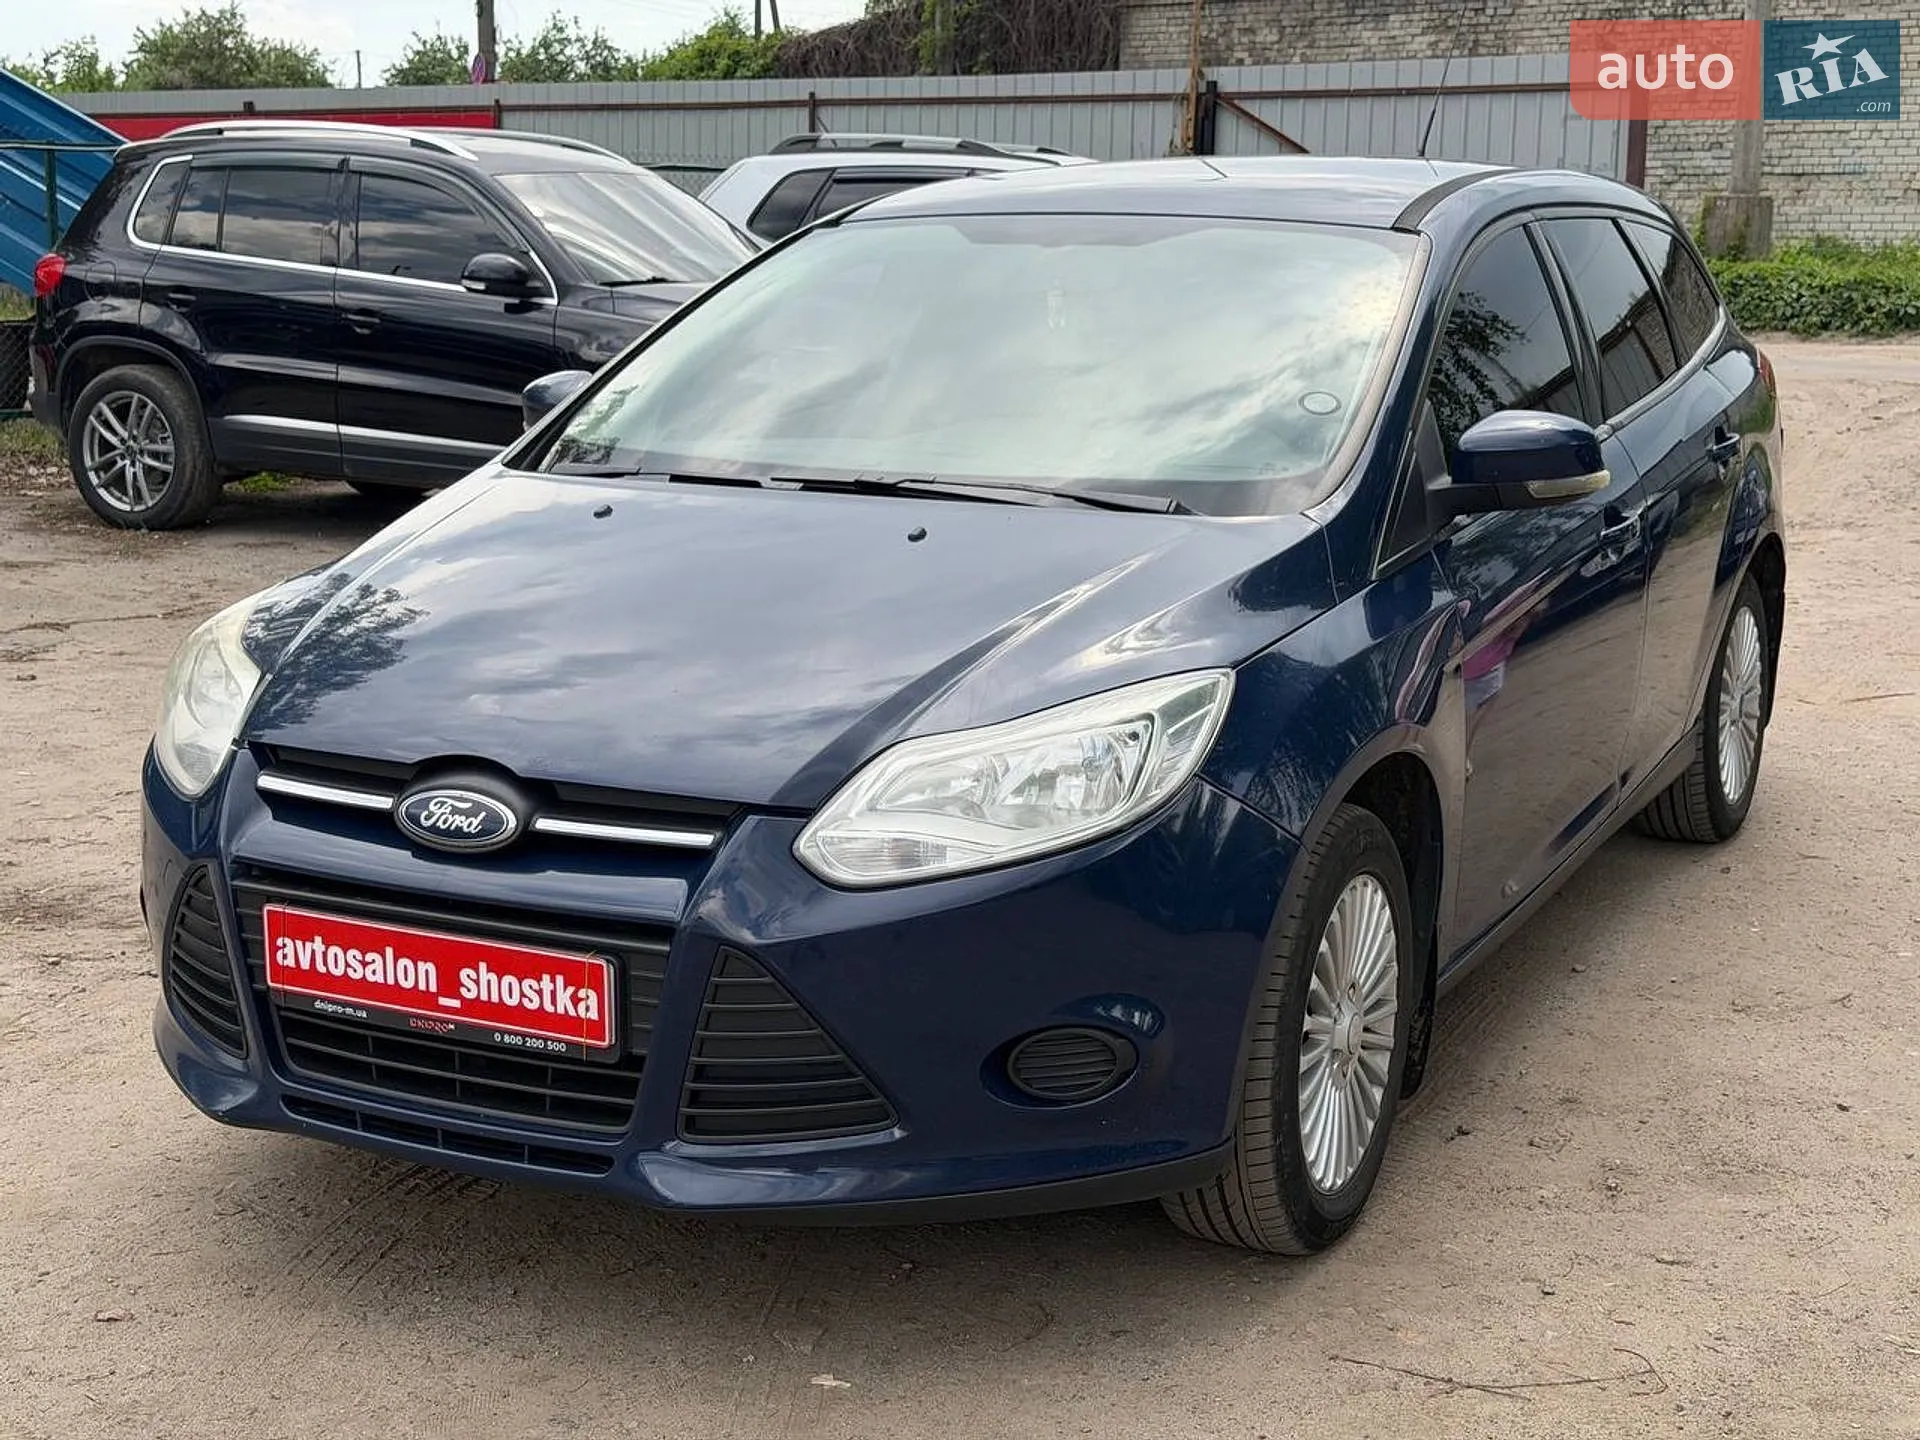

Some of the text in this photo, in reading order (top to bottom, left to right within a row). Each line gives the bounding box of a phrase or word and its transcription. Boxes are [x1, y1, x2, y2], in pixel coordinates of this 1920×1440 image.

[420, 797, 487, 834] Ford
[275, 934, 599, 1021] avtosalon_shostka
[313, 999, 368, 1018] dnipro-m.ua
[493, 1032, 567, 1052] 0 800 200 500
